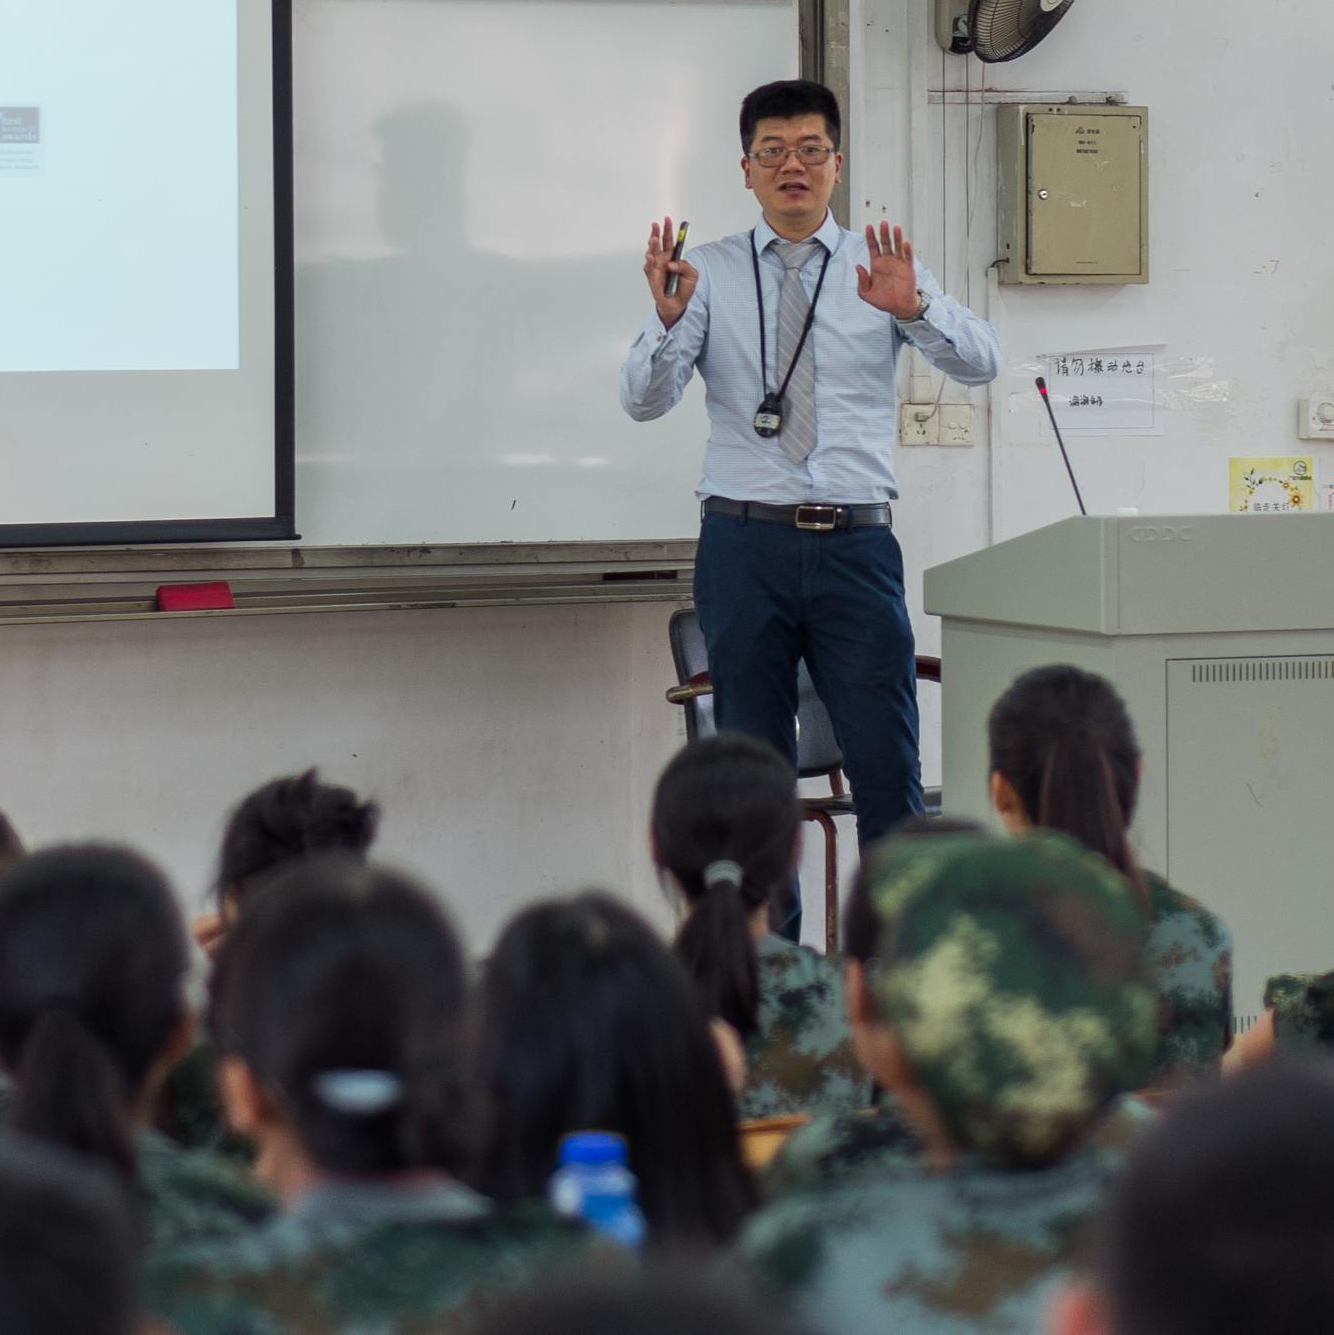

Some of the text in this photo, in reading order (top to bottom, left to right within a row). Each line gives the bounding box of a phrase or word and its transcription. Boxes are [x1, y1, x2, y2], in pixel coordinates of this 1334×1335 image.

[761, 415, 771, 425] 2
[1253, 501, 1291, 511] 临走关灯
